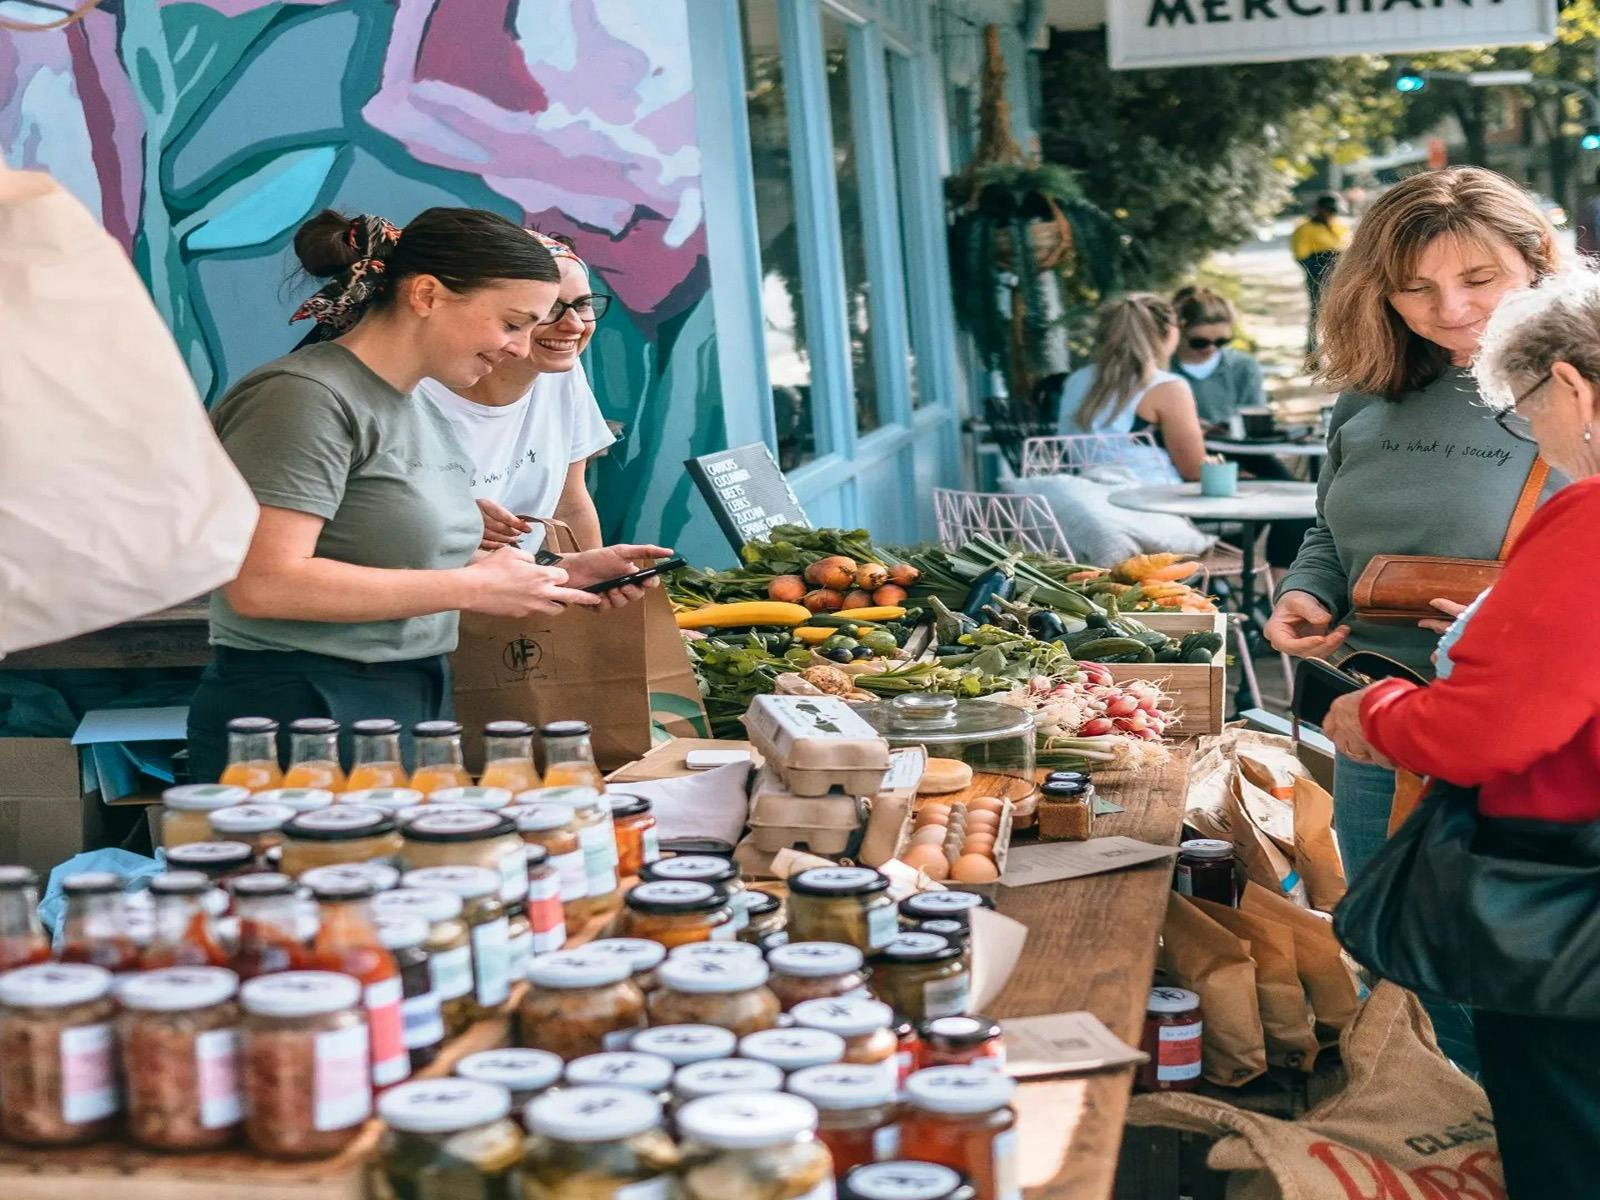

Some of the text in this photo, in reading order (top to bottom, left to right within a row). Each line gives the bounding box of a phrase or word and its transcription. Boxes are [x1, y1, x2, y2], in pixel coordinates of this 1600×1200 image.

[1147, 0, 1502, 28] MERC
[1381, 439, 1400, 451] The
[1406, 439, 1439, 452] What
